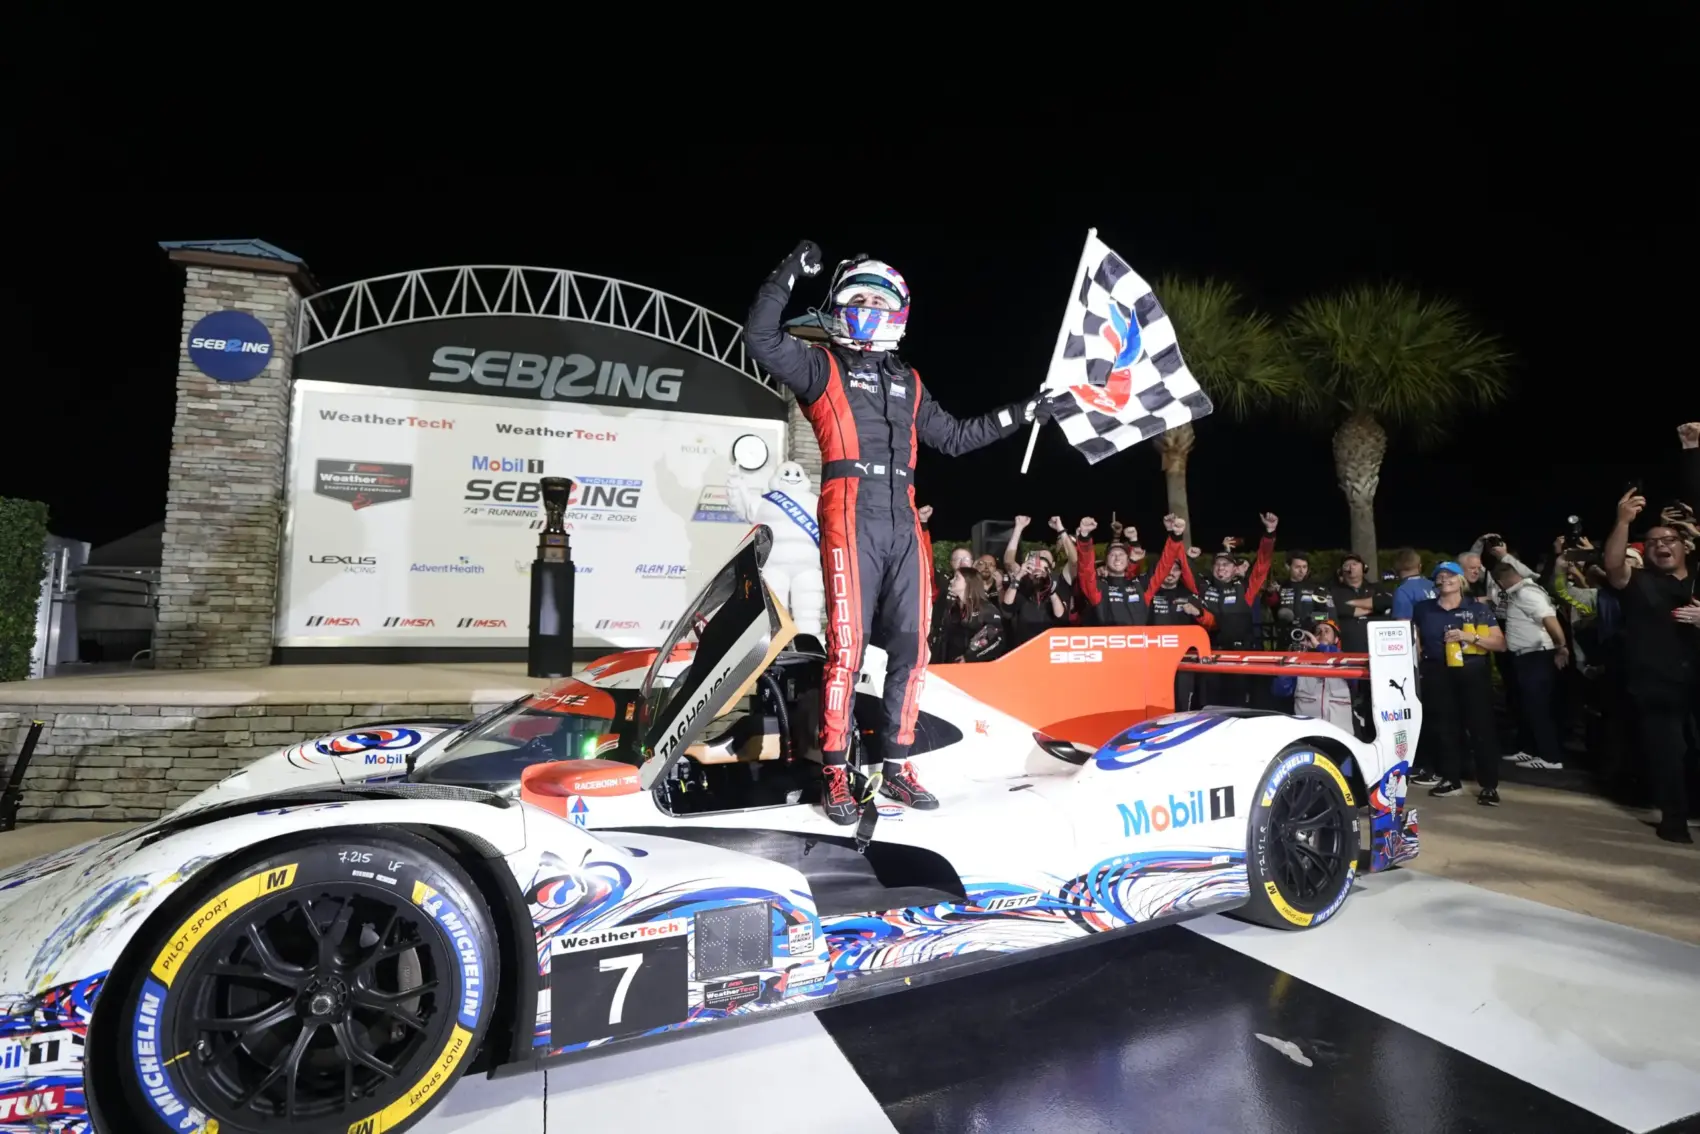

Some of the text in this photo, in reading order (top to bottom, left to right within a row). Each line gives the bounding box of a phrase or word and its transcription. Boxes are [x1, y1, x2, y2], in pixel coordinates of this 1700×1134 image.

[319, 410, 453, 430] WeatherTech
[496, 423, 617, 442] WeatherTech
[472, 455, 543, 474] Mobil 1
[464, 479, 642, 508] SEBING
[488, 508, 538, 517] RUNNING
[607, 514, 637, 523] 2026
[309, 555, 377, 566] LEXUS
[635, 564, 687, 576] ALAN JAY
[323, 617, 361, 627] IMSA
[400, 618, 435, 628] IMSA
[473, 619, 508, 628] IMSA
[828, 547, 853, 711] PORSCHE
[1049, 634, 1179, 650] PORSCHE
[1050, 650, 1103, 664] 963
[1381, 708, 1411, 722] Mobil 1
[365, 754, 402, 765] Mobil
[575, 813, 586, 826] N
[1116, 790, 1204, 838] Mobil
[388, 860, 404, 872] LF
[266, 869, 288, 890] M
[1004, 895, 1038, 908] GTP
[162, 898, 230, 970] PILOT SPORT
[560, 922, 680, 949] WeatherTech
[439, 911, 480, 1018] MICHELIN
[599, 953, 644, 1025] 7
[137, 992, 185, 1117] MICHELIN
[409, 1038, 463, 1107] PILOT SPORT
